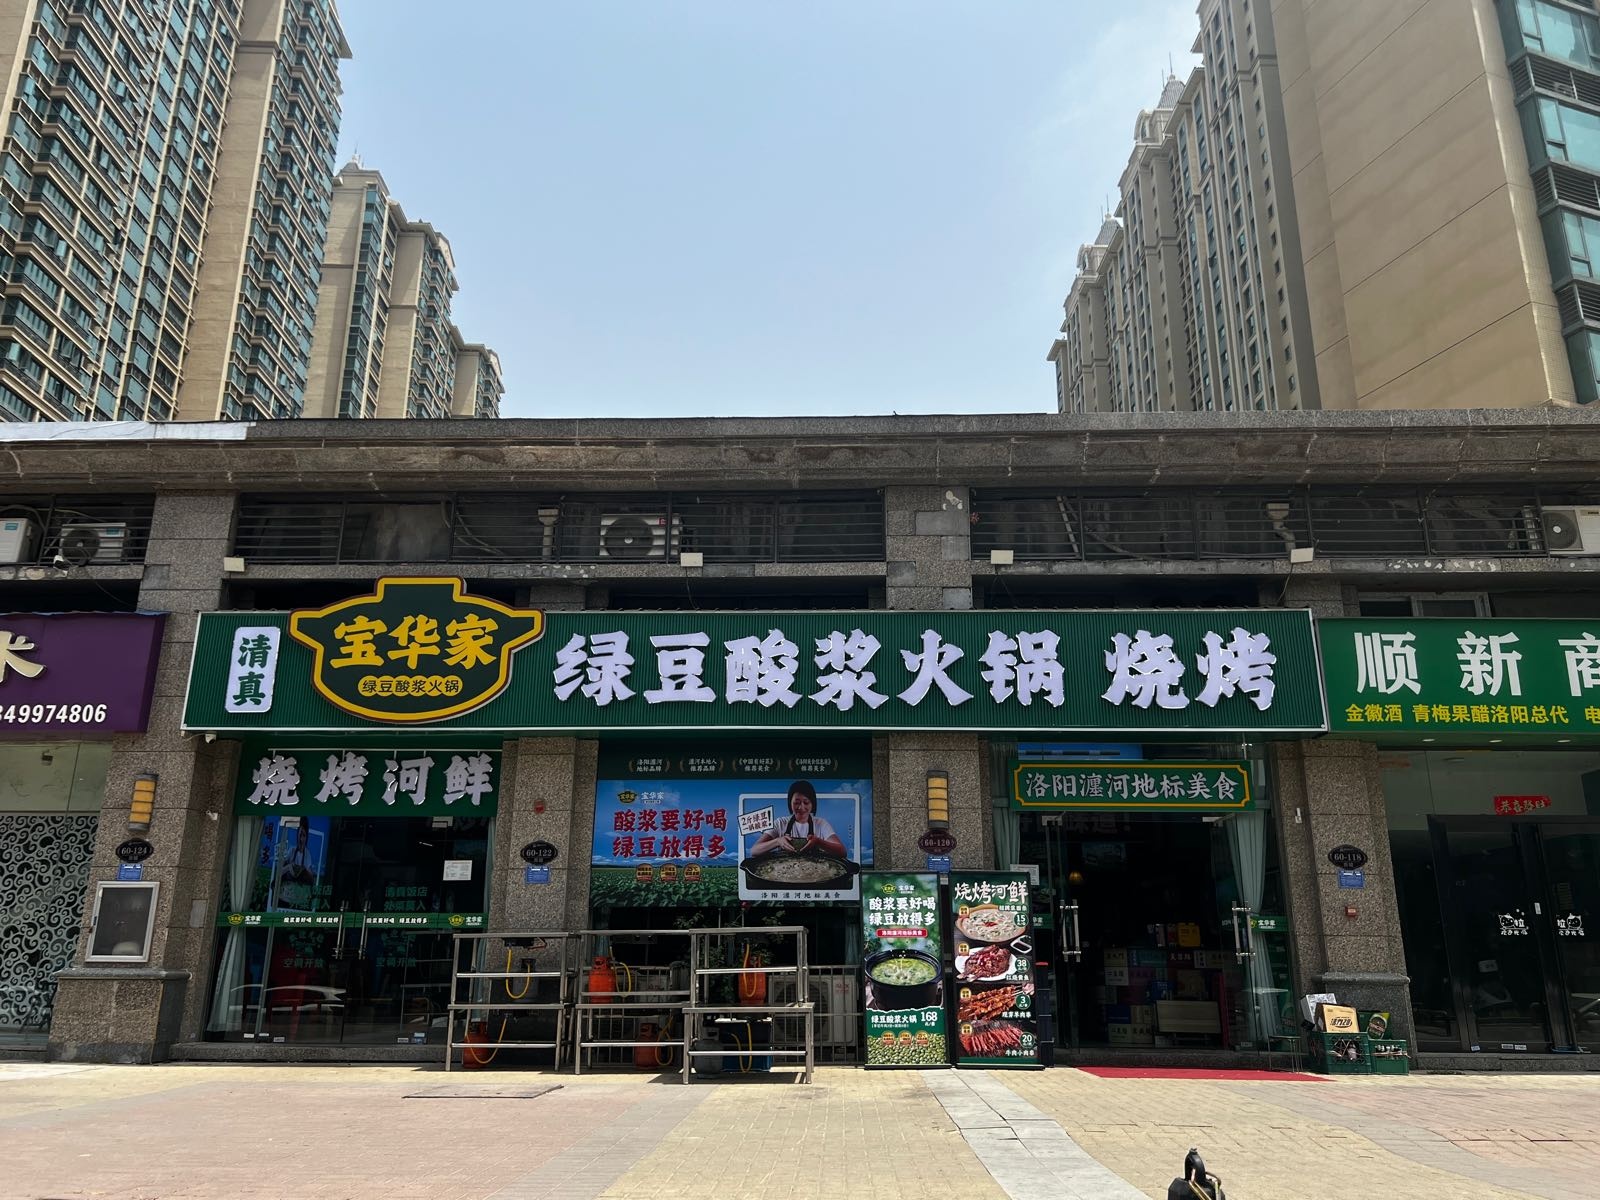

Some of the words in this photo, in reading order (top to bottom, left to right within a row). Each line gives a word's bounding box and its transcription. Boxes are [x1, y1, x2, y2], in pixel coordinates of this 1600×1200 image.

[330, 613, 499, 670] 宝华家
[232, 633, 273, 706] 清真
[553, 628, 1065, 711] 绿豆酸浆火锅
[1101, 627, 1277, 711] 烧烤
[1354, 630, 1600, 697] 顺新商
[362, 679, 460, 694] 绿豆酸浆火锅
[0, 703, 108, 724] 49974806
[1345, 704, 1402, 723] 金徽酒
[1412, 704, 1569, 724] 青梅果醋洛阳总代
[247, 751, 495, 806] 烧烤河鲜
[1025, 771, 1239, 801] 洛阳瀍河地标美食
[614, 809, 727, 832] 酸浆要好喝
[612, 835, 726, 858] 绿豆放得多
[954, 881, 1029, 904] 烧烤河鲜
[869, 896, 936, 911] 酸浆要好喝
[869, 912, 936, 926] 绿豆放得多
[1016, 959, 1027, 967] 38
[1020, 996, 1026, 1004] 3
[871, 1015, 917, 1024] 绿豆酸浆火锅
[920, 1011, 938, 1022] 168
[1022, 1034, 1032, 1043] 20
